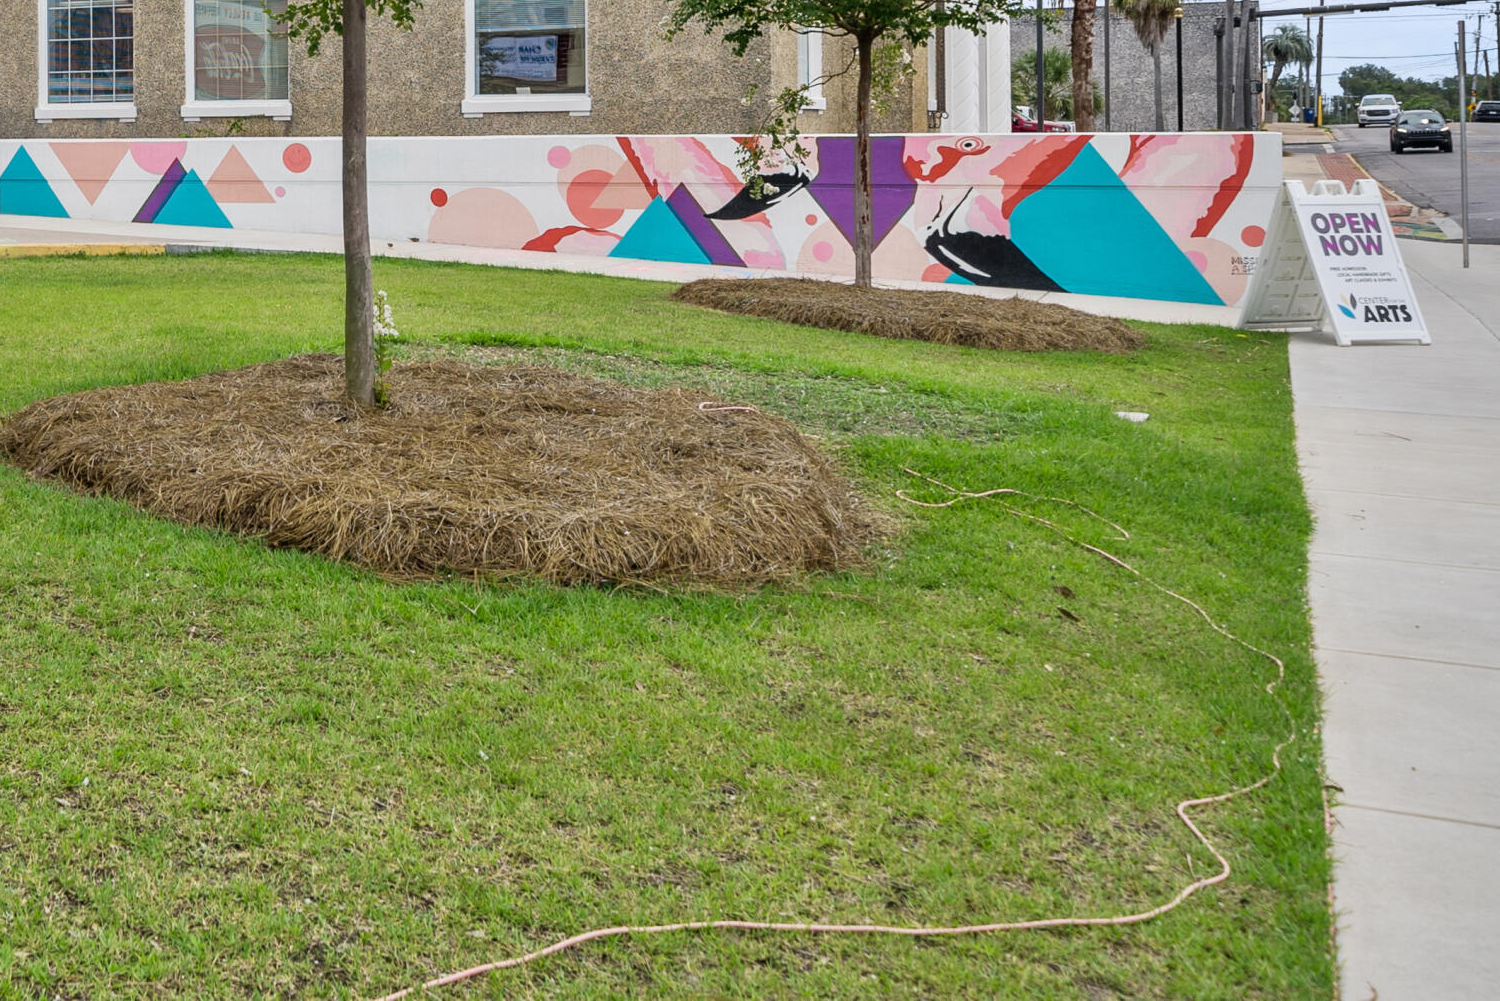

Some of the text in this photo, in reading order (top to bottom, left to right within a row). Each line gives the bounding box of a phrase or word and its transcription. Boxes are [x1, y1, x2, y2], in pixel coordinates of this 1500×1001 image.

[1311, 213, 1382, 234] OPEN
[1318, 235, 1383, 256] NOW
[1358, 296, 1388, 304] CENTER
[1364, 304, 1412, 322] ARTS
